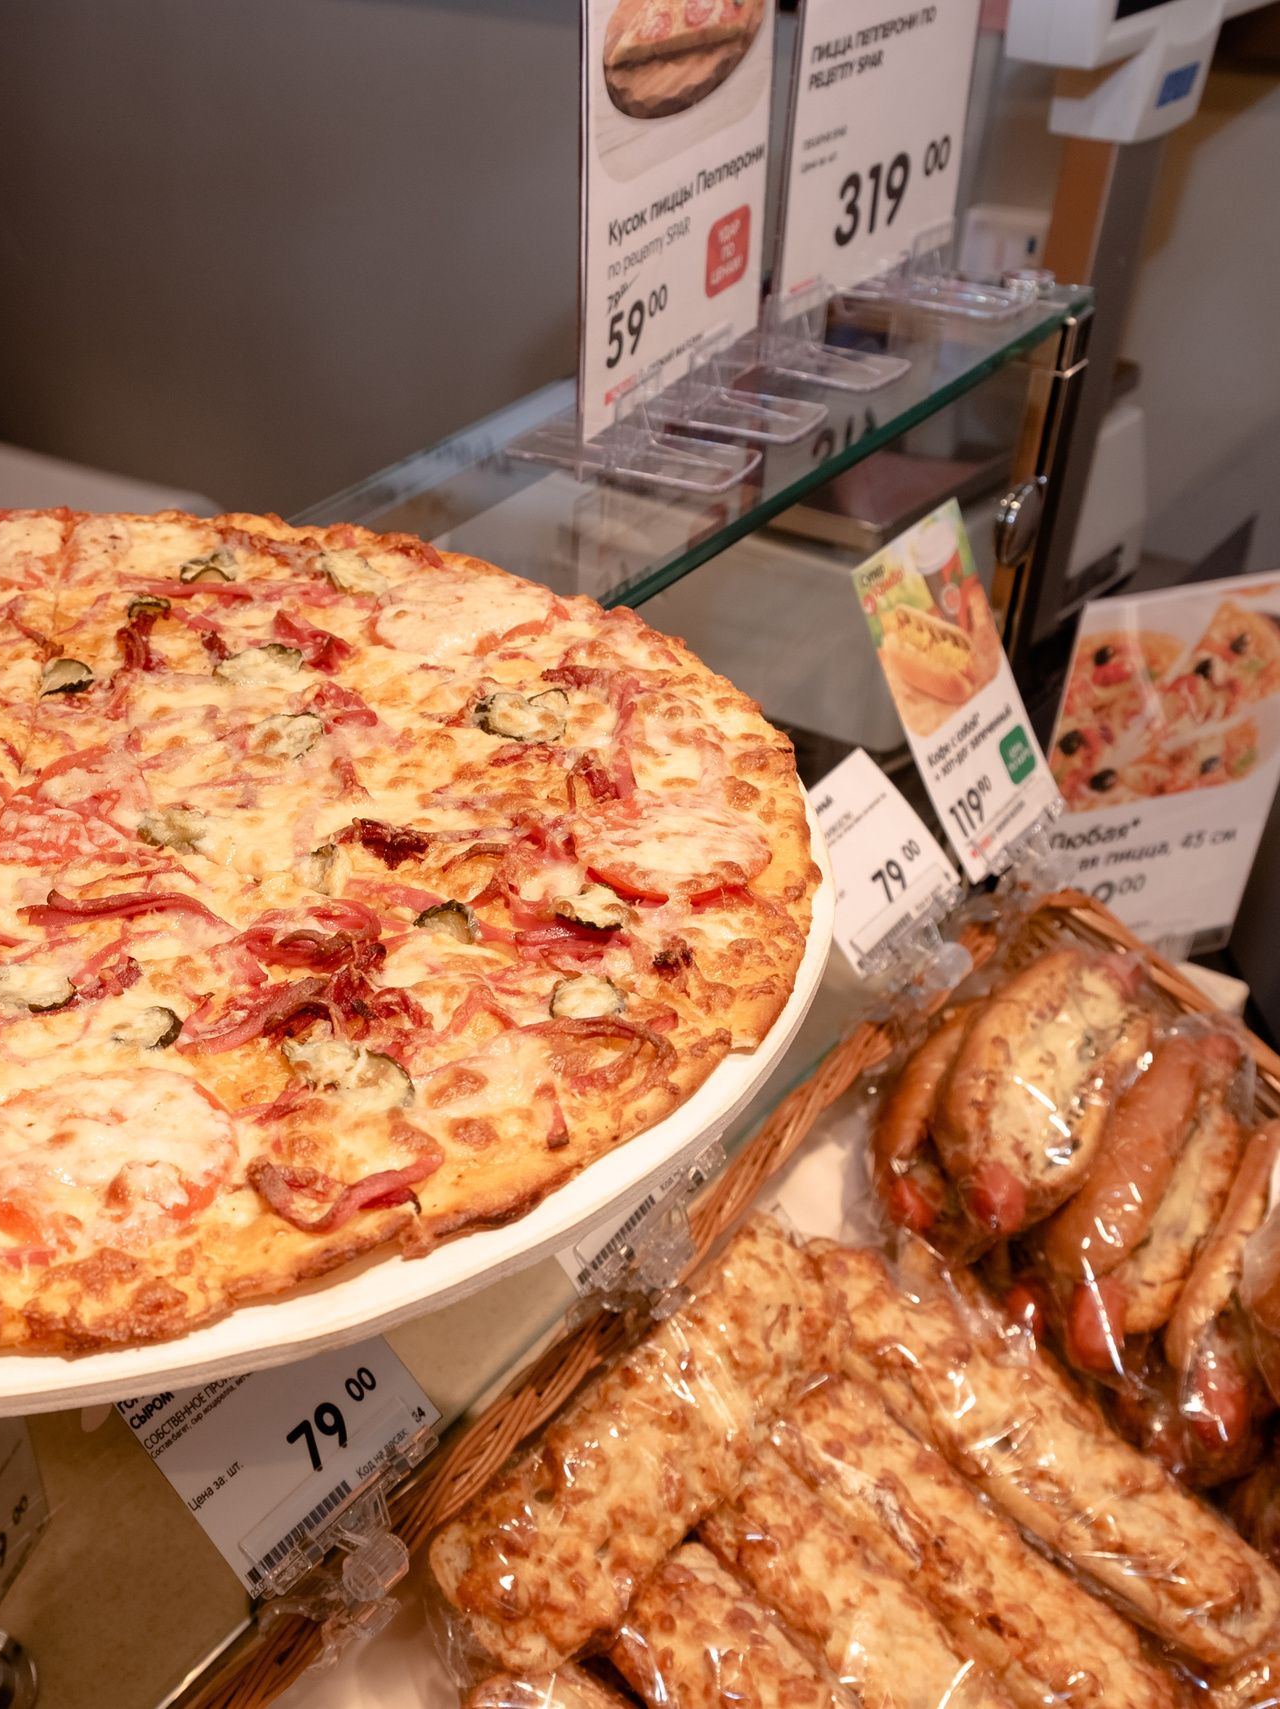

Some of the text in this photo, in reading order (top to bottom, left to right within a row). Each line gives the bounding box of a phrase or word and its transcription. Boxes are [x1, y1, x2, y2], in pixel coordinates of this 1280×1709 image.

[857, 49, 884, 75] SPAR
[608, 142, 766, 247] Кусок пиццы Пепперони
[835, 133, 951, 246] 319 00
[607, 216, 691, 280] по рецепту SPAR
[606, 299, 645, 369] 59
[648, 283, 668, 317] 00
[970, 703, 1013, 750] запеченный
[927, 741, 952, 768] Кофе
[949, 787, 984, 838] 119
[977, 774, 992, 796] 90
[871, 838, 921, 903] 79 00
[1104, 842, 1172, 868] пицца,
[1180, 829, 1207, 849] 45
[1210, 828, 1237, 846] см
[1120, 873, 1147, 895] 00
[129, 1391, 175, 1430] СЫРОМ
[143, 1392, 207, 1450] СОБСТВЕННОЕ
[190, 1413, 203, 1425] сыр
[286, 1367, 376, 1472] 79 00
[187, 1461, 244, 1512] Цена за: шт.
[355, 1461, 375, 1480] Код
[373, 1453, 386, 1466] на
